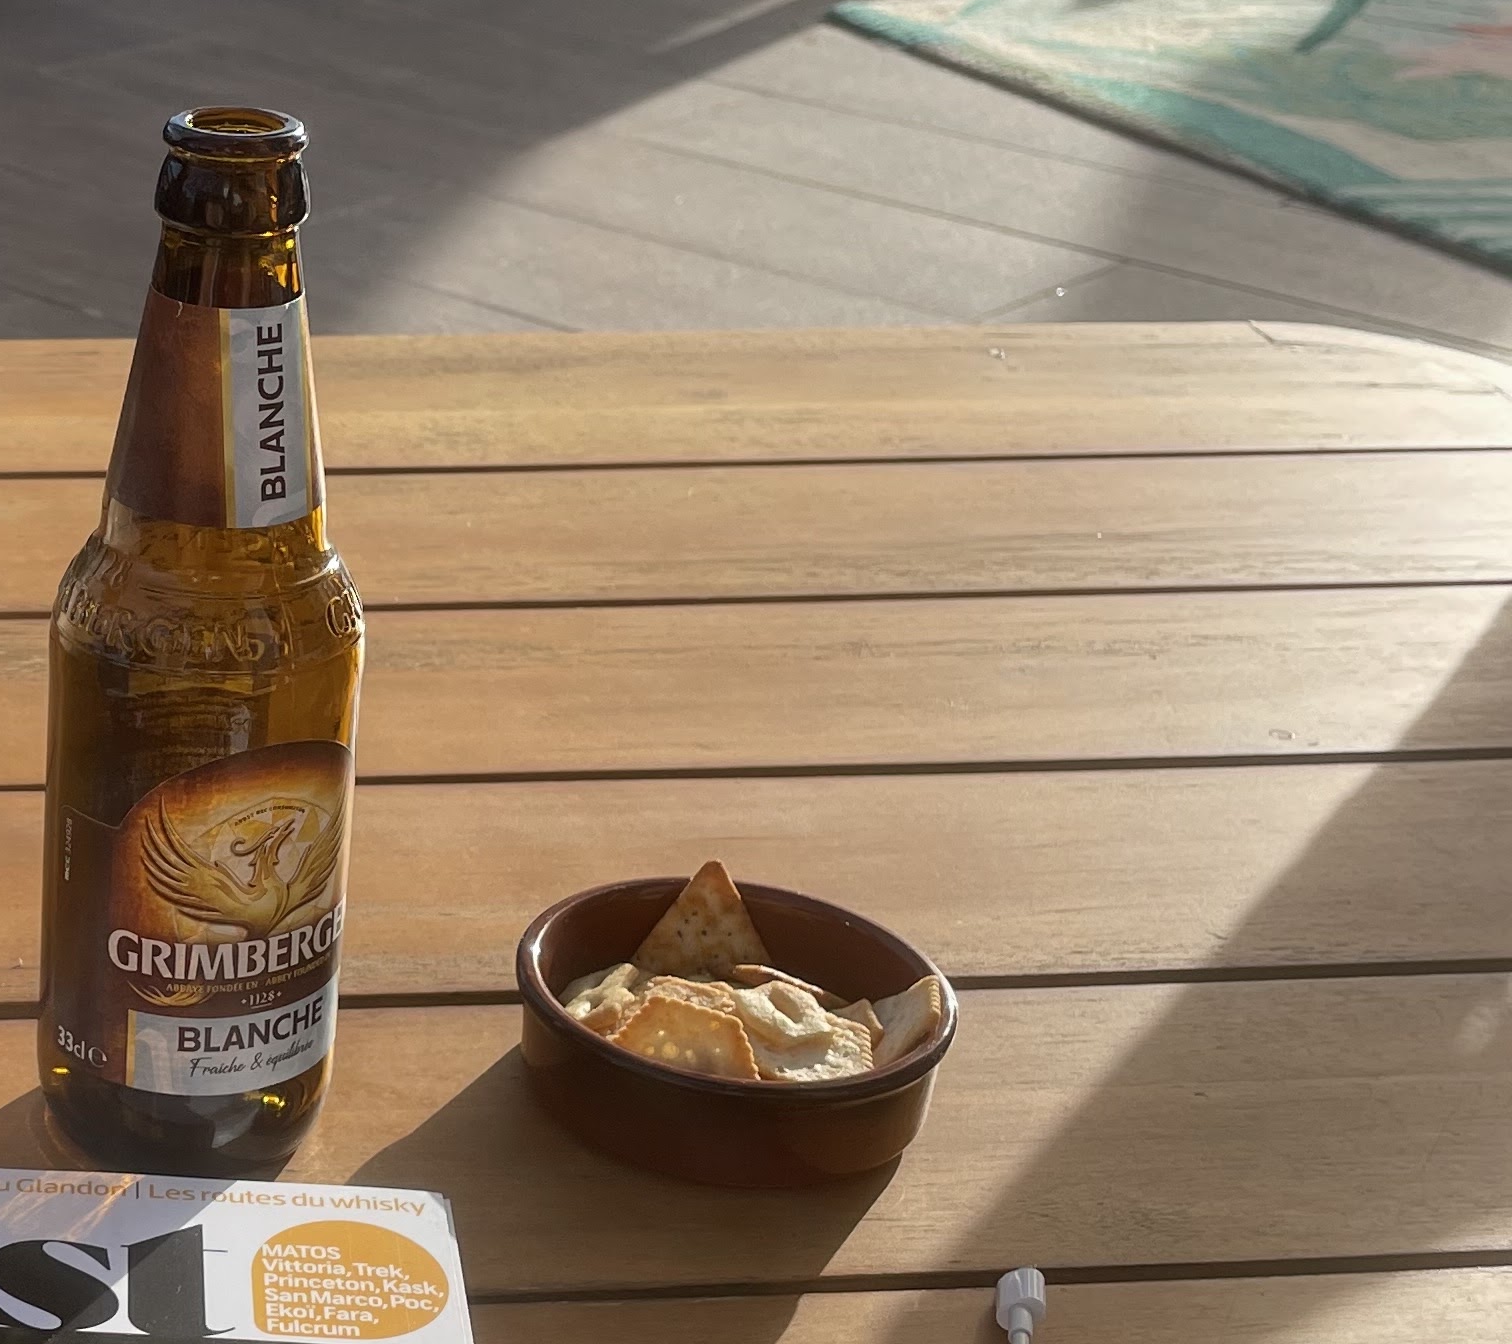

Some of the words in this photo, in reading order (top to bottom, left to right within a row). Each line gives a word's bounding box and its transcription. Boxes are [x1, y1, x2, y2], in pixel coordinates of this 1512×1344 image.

[256, 322, 288, 503] BLANCHE
[107, 897, 345, 981] GRIMBERGE
[249, 990, 275, 1006] 1128
[177, 994, 324, 1053] BLANCHE
[57, 1024, 85, 1060] 33cl
[250, 1052, 264, 1070] &
[16, 1177, 128, 1197] Glandon
[148, 1183, 196, 1201] Les
[200, 1189, 287, 1206] routes
[291, 1191, 325, 1208] du
[330, 1196, 427, 1217] whisky
[261, 1243, 342, 1260] MATOS
[262, 1258, 353, 1277] Vittoria,
[352, 1262, 410, 1281] Trek,
[263, 1273, 381, 1294] Princeton,
[382, 1279, 445, 1298] Kask,
[264, 1287, 308, 1303] San
[310, 1290, 389, 1310] Marco,
[390, 1294, 440, 1313] Poc,
[266, 1318, 361, 1337] Fulcrum
[323, 1306, 380, 1325] Fara,
